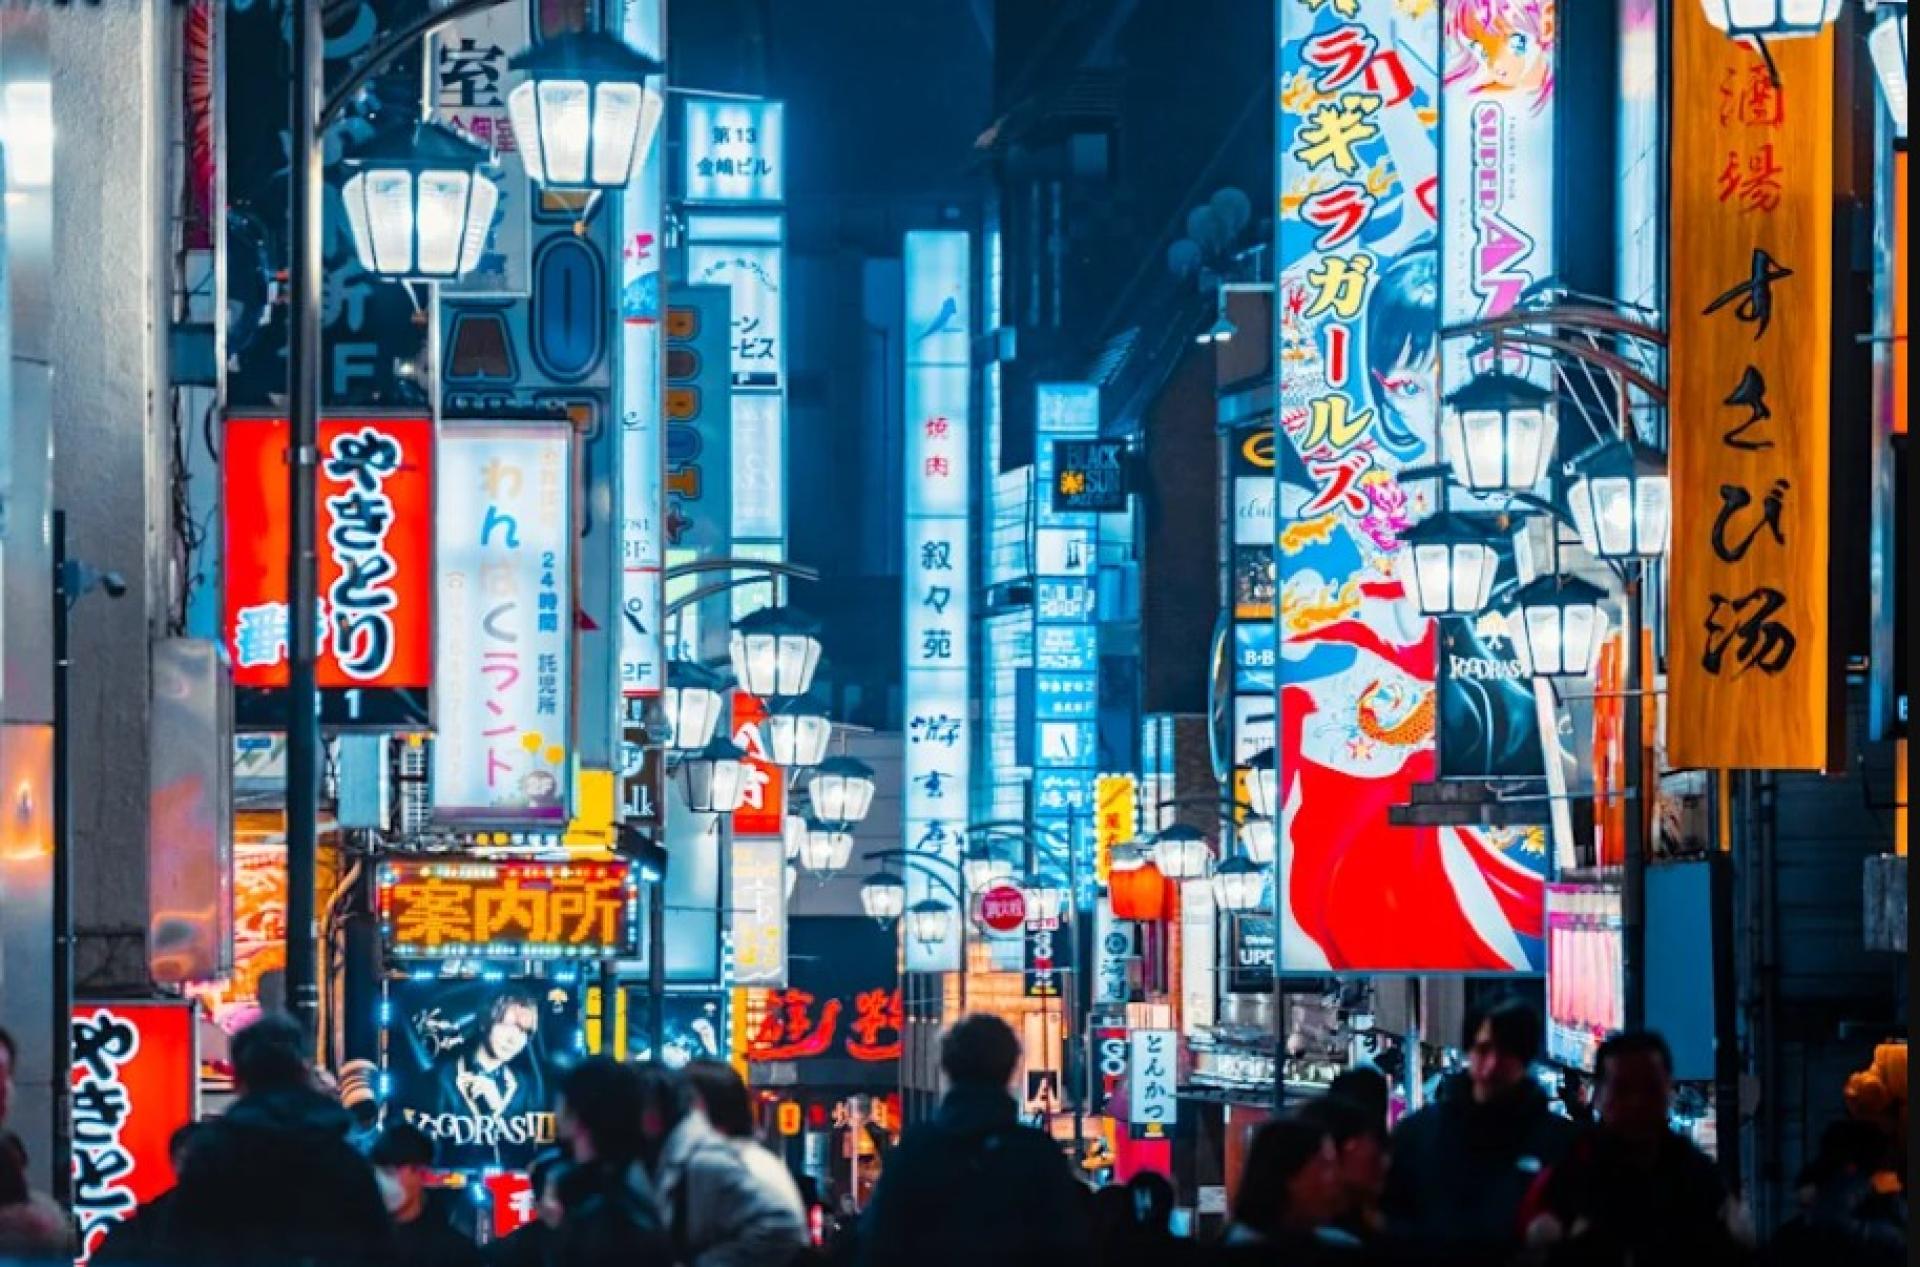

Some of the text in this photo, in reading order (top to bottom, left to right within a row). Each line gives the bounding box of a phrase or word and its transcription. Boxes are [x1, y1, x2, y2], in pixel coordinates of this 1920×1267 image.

[440, 39, 505, 107] 室
[325, 428, 399, 678] やきとり
[390, 877, 625, 945] 案内所
[1144, 1032, 1167, 1119] とんかつ
